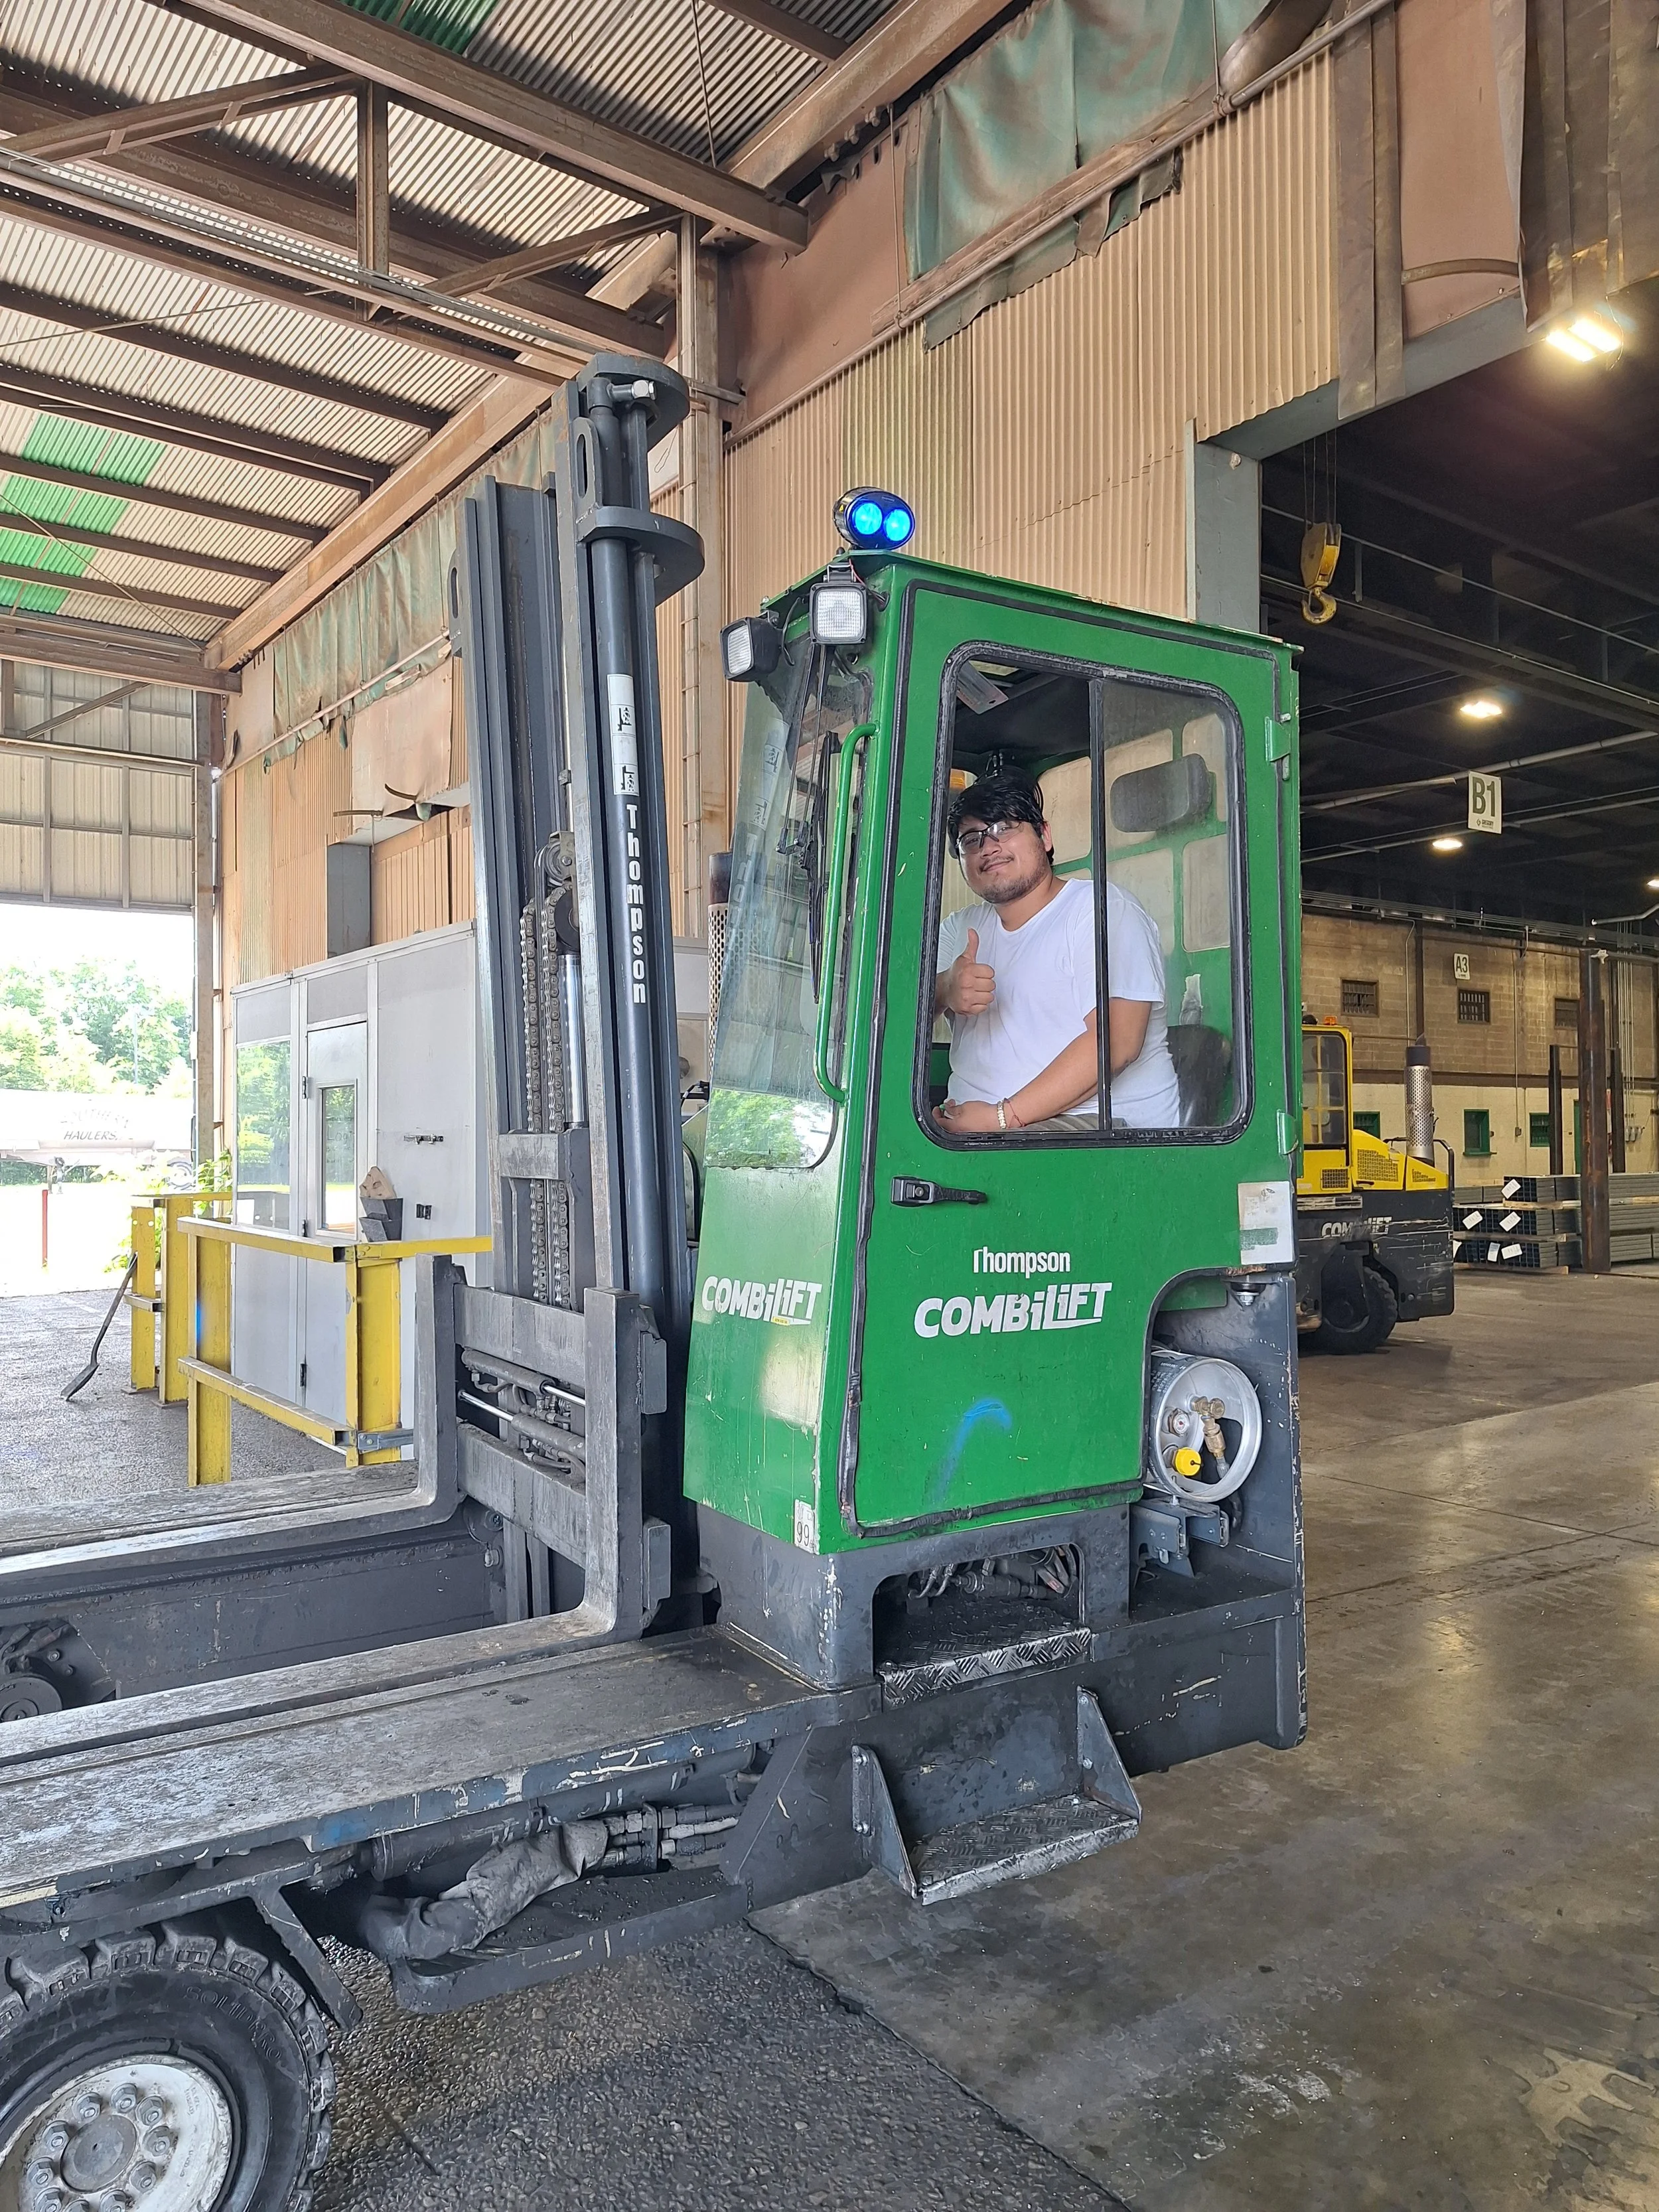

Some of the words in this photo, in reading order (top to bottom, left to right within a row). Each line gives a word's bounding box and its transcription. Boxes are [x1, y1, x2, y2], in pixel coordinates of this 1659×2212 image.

[1473, 776, 1495, 817] B1
[626, 804, 646, 1003] Thompson
[1456, 956, 1467, 973] A3
[973, 1246, 1070, 1279] Thompson
[797, 1521, 810, 1546] 99
